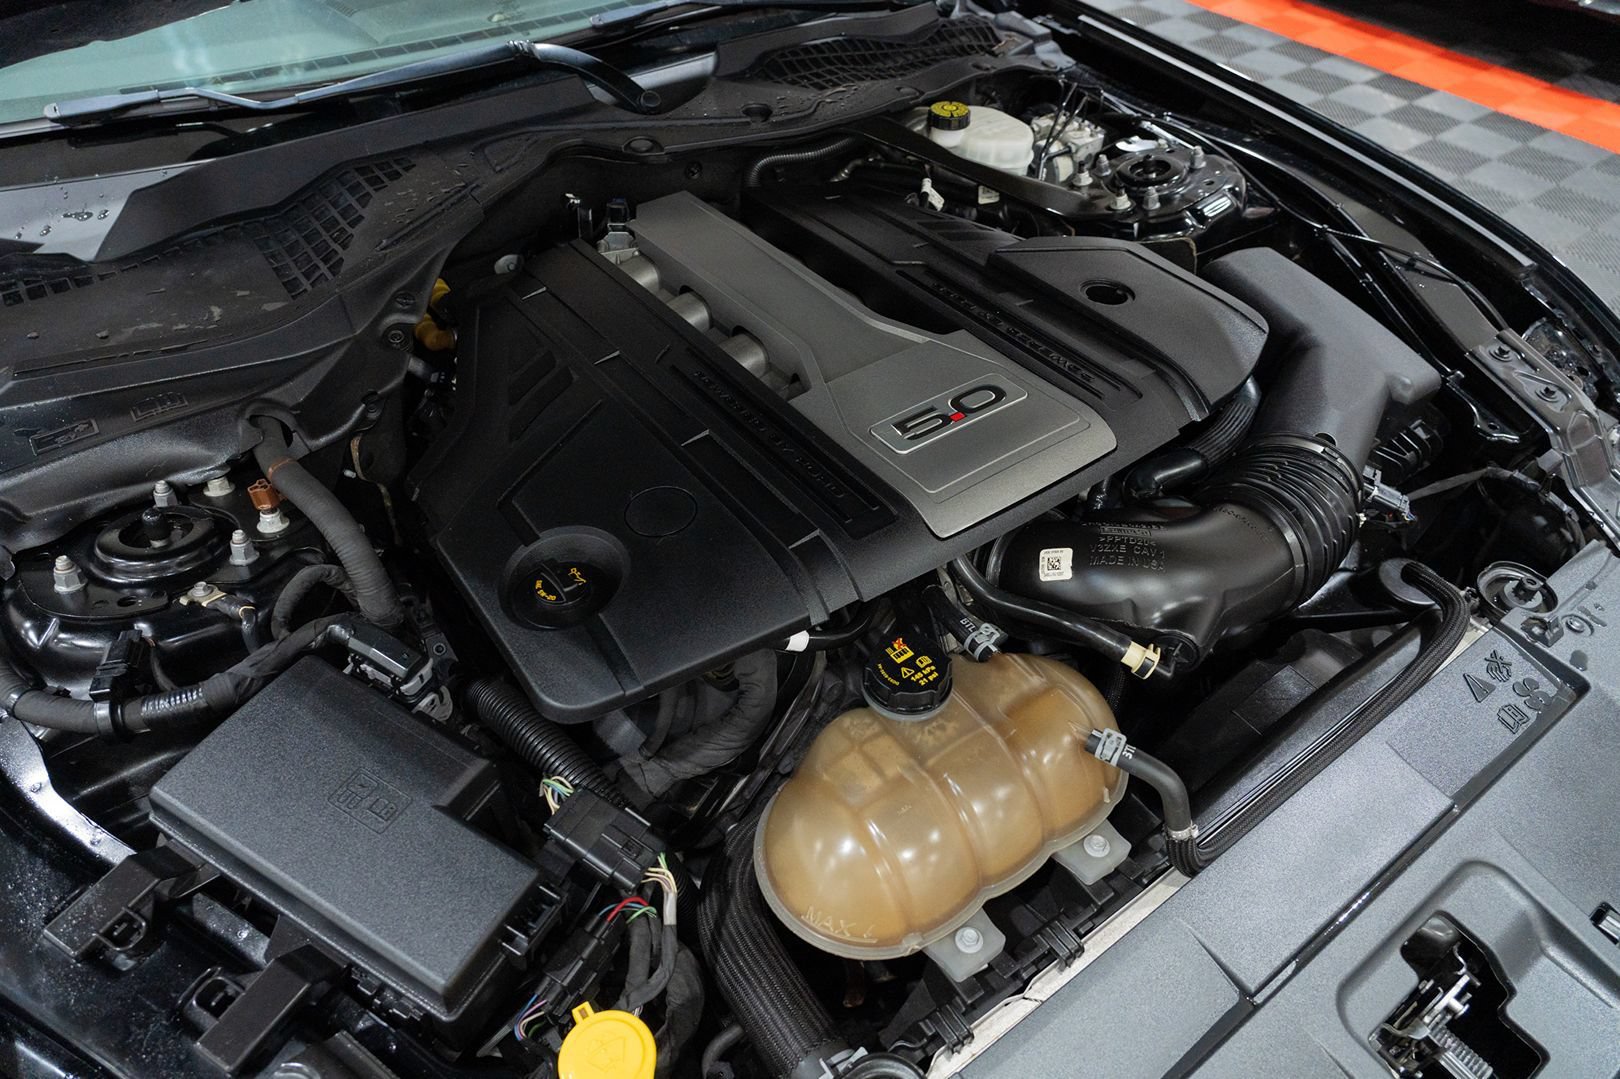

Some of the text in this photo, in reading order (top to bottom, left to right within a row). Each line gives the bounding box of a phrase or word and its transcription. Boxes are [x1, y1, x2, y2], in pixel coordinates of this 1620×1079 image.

[890, 384, 1007, 441] 5.0
[1089, 555, 1124, 566] MADE
[1127, 556, 1139, 567] IN
[960, 618, 975, 632] BTL
[910, 672, 924, 682] 145
[918, 678, 928, 686] 21
[806, 905, 857, 937] MAX
